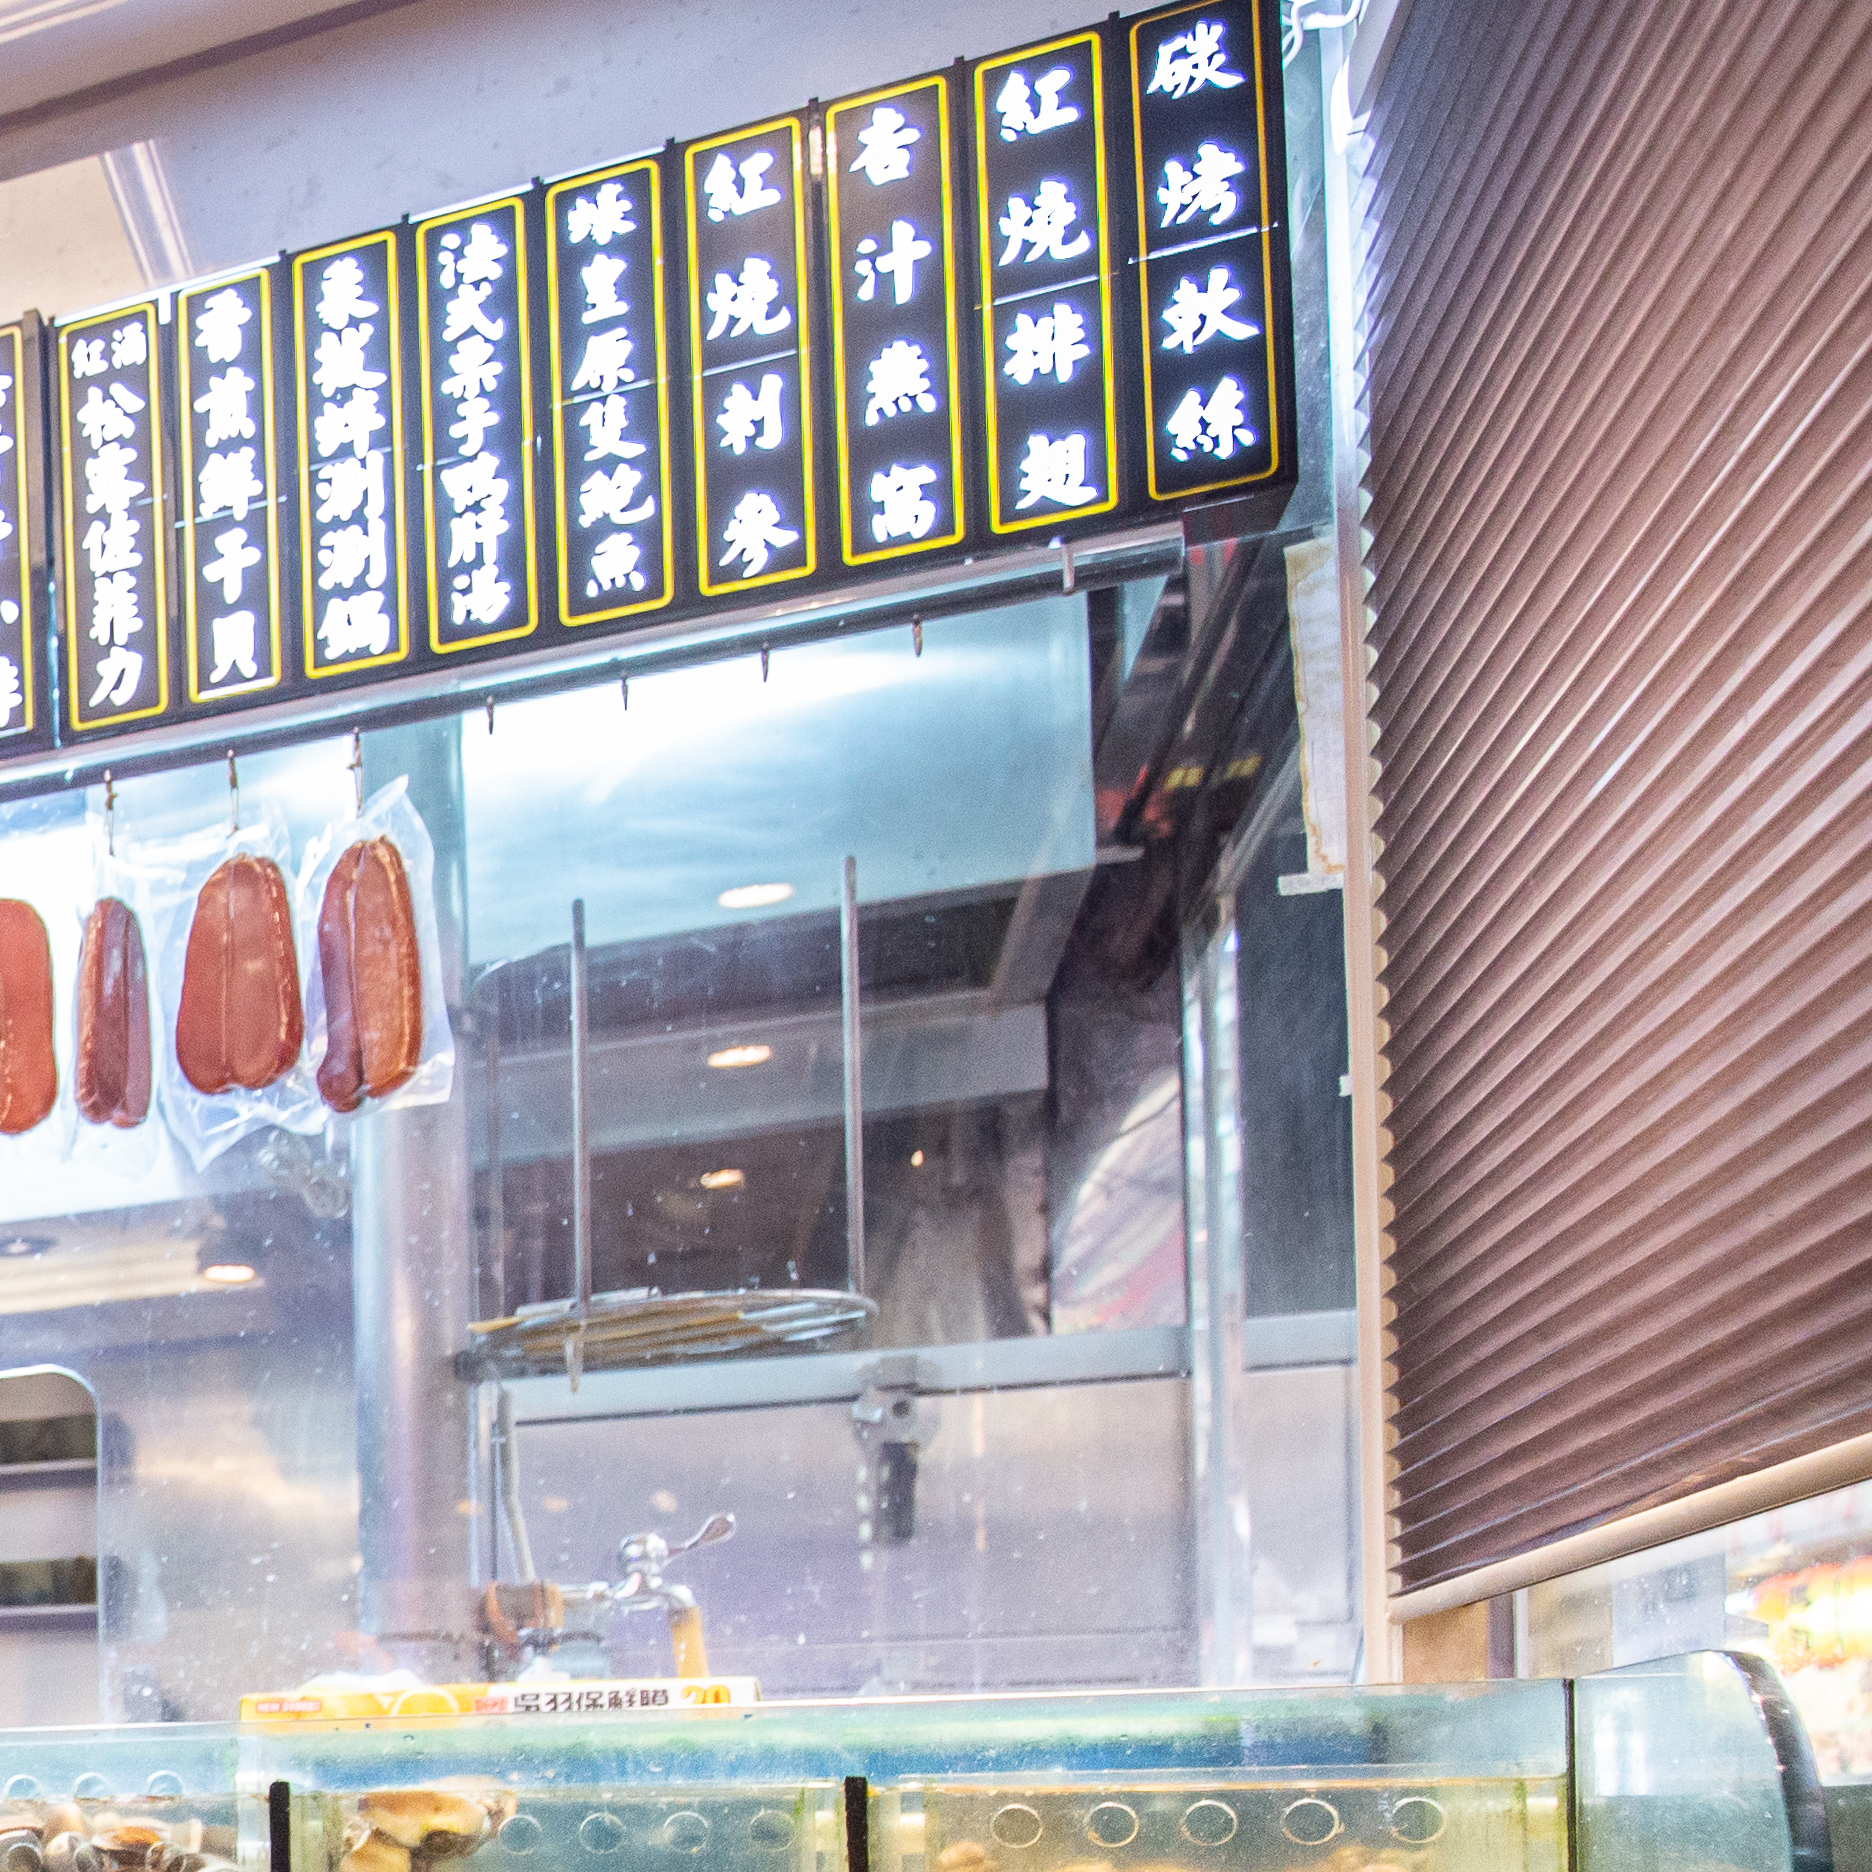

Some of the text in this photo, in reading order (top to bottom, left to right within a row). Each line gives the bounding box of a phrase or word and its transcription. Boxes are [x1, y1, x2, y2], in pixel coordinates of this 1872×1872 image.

[705, 153, 799, 577] 紅燒刺參
[850, 109, 938, 541] 杏汁燕窩
[997, 70, 1099, 508] 紅燒排翅
[1149, 24, 1258, 460] 碳烤軟絲
[194, 289, 263, 682] 香煎鮮干貝
[680, 1684, 731, 1706] 20
